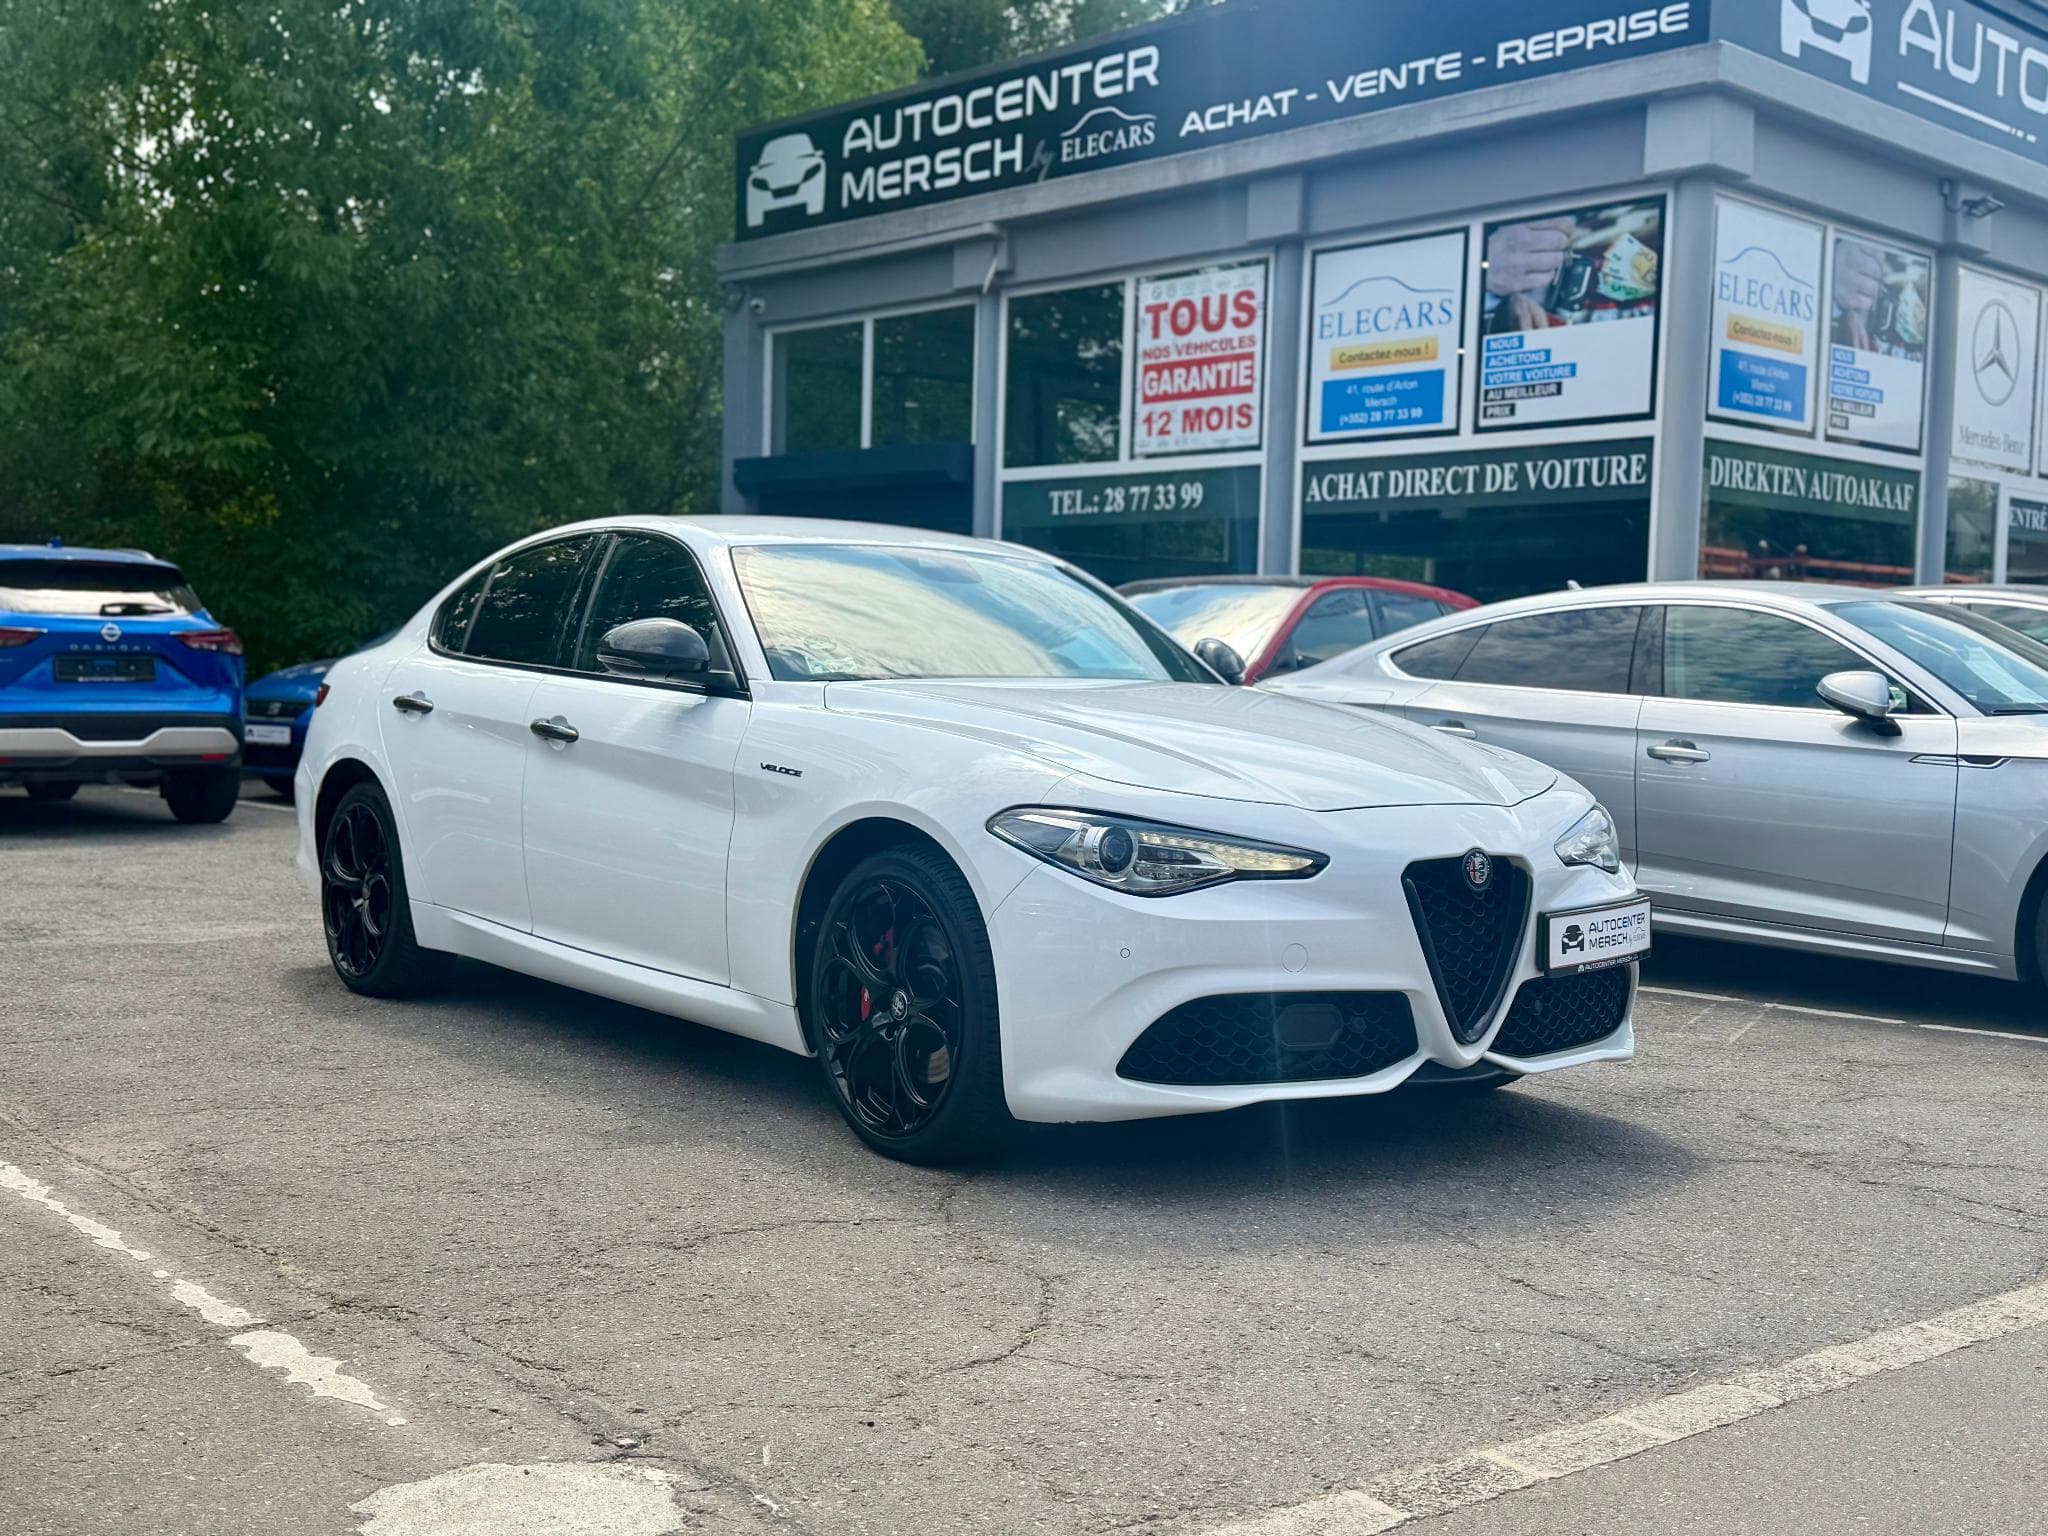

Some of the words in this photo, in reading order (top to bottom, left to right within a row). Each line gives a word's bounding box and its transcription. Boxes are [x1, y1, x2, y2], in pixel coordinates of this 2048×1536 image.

[1179, 89, 1298, 137] ACHAT
[1327, 52, 1462, 103] VENTE
[1496, 2, 1690, 69] REPRISE
[1899, 0, 2048, 115] AUTO
[842, 45, 1160, 159] AUTOCENTER
[842, 133, 1023, 208] MERSCH
[1061, 121, 1156, 163] ELECARS
[1719, 271, 1815, 322] ELECARS
[1145, 289, 1257, 340] TOUS
[1319, 298, 1455, 340] ELECARS
[1143, 345, 1170, 360] NOS
[1339, 346, 1422, 364] Contactez-nous
[1489, 351, 1547, 367] ACHETONS
[1490, 336, 1520, 350] NOUS
[1143, 360, 1253, 396] GARANTIE
[1488, 369, 1523, 384] VOTRE
[1526, 365, 1572, 380] VOITURE
[1142, 411, 1172, 437] 12
[1182, 403, 1254, 434] MOIS
[1306, 471, 1384, 502] ACHAT
[1388, 465, 1479, 498] DIRECT
[1484, 462, 1518, 492] DE
[1525, 454, 1647, 490] VOITURE
[1710, 455, 1806, 497] DIREKTEN
[1810, 471, 1914, 511] AUTOAKAAF
[1049, 488, 1099, 516] TEL.:
[1103, 487, 1125, 513] 28
[1129, 485, 1151, 511] 77
[1153, 484, 1175, 510] 33
[1180, 482, 1204, 508] 99
[760, 762, 803, 778] VELOCE
[1589, 912, 1645, 935] AUTOCENTER
[1589, 933, 1627, 950] MERSCH
